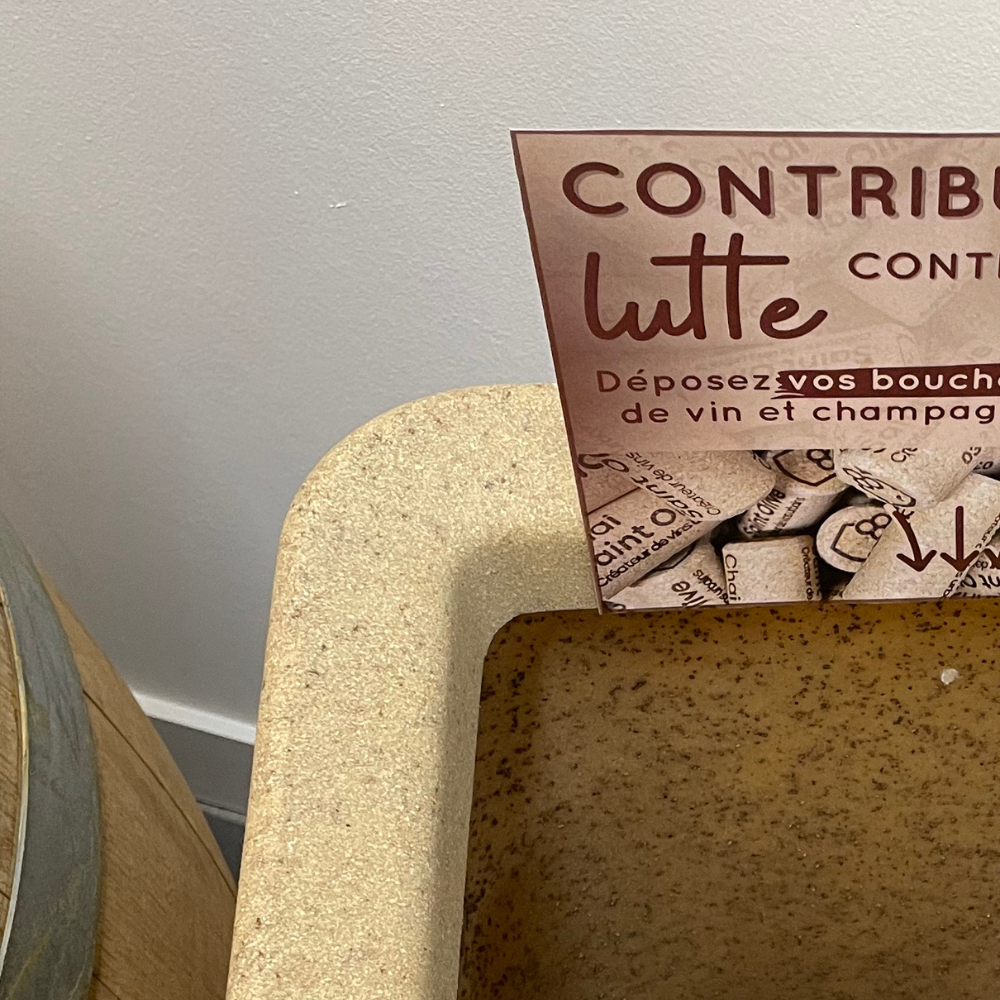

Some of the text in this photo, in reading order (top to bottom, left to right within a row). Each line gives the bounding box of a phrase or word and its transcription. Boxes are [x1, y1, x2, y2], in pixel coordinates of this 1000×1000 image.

[584, 232, 828, 341] lutte
[596, 369, 771, 398] Déposez
[787, 372, 857, 392] vos
[621, 402, 670, 424] de
[685, 401, 743, 423] vin
[760, 401, 796, 423] et
[653, 468, 673, 484] de
[594, 525, 656, 567] aint
[724, 554, 741, 602] Chai
